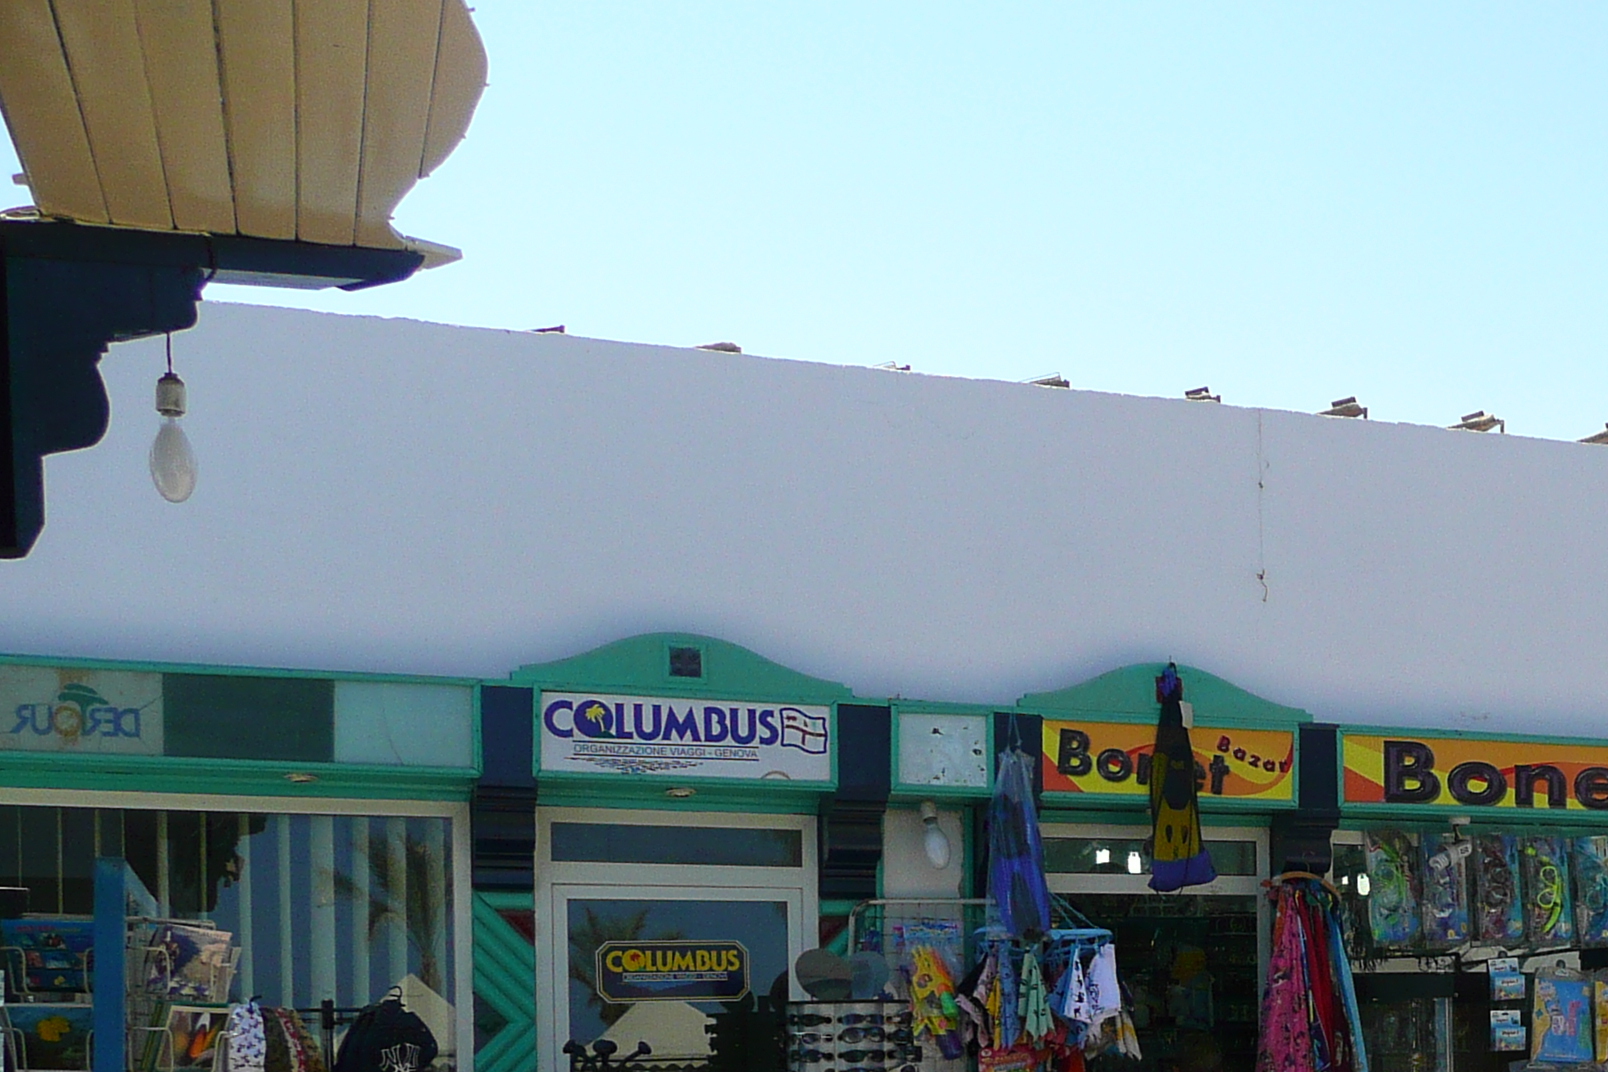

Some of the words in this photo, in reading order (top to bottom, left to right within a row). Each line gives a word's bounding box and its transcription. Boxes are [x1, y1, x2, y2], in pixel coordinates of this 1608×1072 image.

[544, 699, 779, 746] COLUMBUS
[573, 743, 668, 756] ORGANIZZAZIONE
[669, 747, 706, 757] VIAGGI
[714, 748, 758, 758] GENOVA
[1216, 735, 1290, 773] Bazar
[605, 949, 740, 973] COLUMBUS
